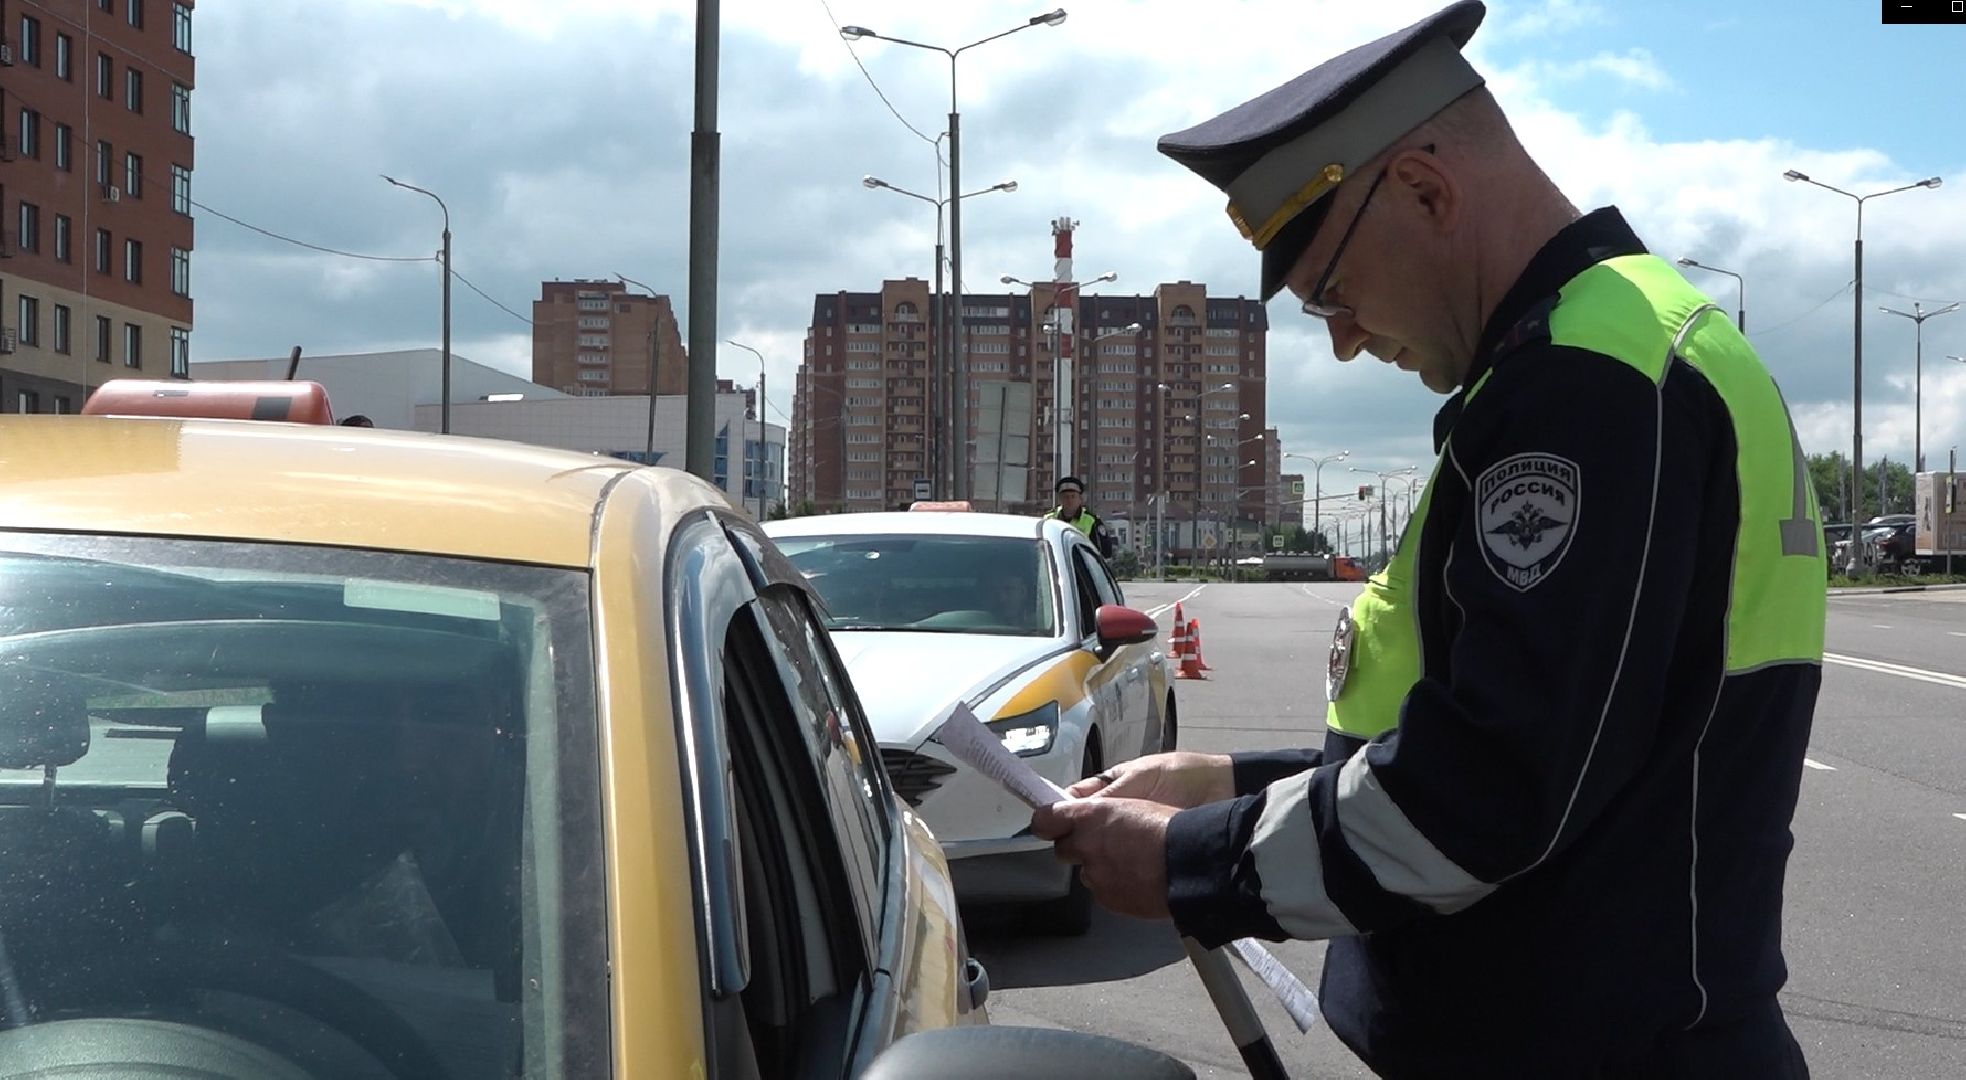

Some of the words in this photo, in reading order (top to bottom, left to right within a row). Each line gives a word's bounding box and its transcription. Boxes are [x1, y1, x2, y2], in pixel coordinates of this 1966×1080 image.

[1484, 460, 1571, 493] ПОЛИЦИЯ
[1490, 481, 1566, 515] РОССИЯ
[1507, 563, 1541, 586] МВД
